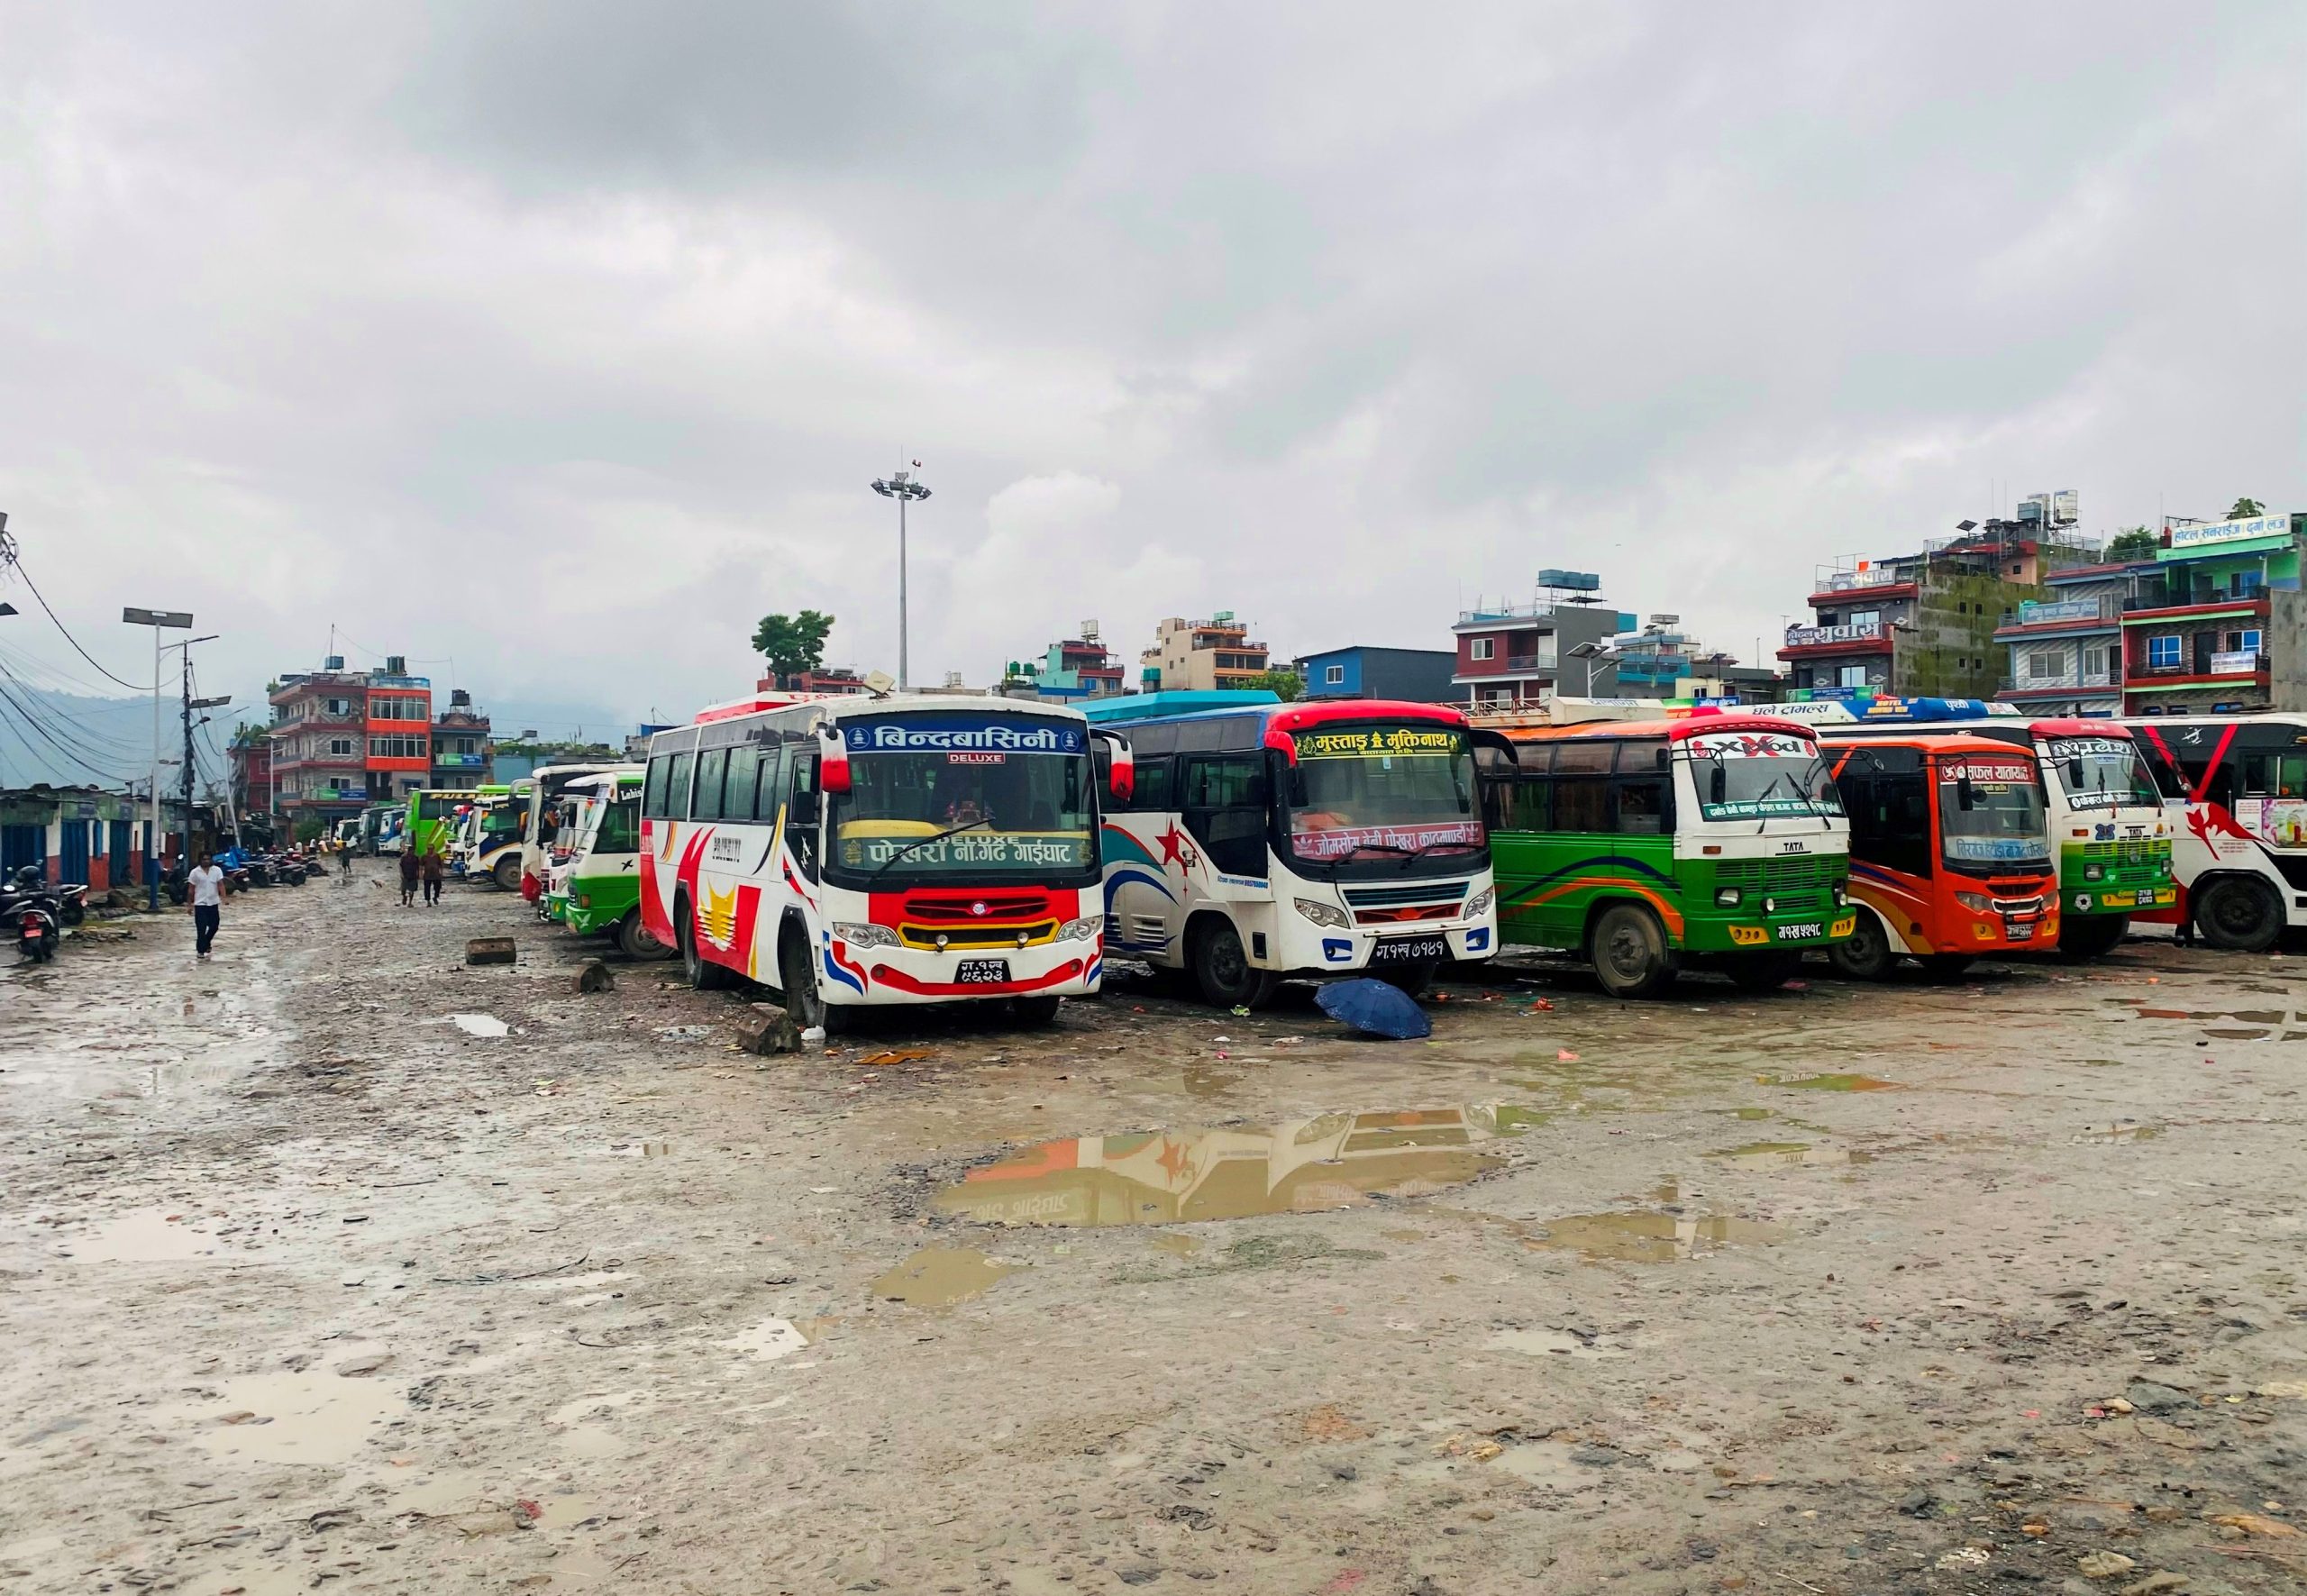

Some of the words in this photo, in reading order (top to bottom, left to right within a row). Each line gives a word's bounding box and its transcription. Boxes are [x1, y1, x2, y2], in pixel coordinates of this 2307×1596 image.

[1813, 624, 1881, 643] सुवास
[1386, 728, 1448, 750] मुक्तिनाथ
[949, 753, 1003, 763] DELUXE
[1994, 766, 2029, 780] यातायात
[2129, 828, 2143, 836] TATA
[1315, 833, 1360, 856] जोमसोम
[1386, 828, 1417, 851] पोखरा
[1783, 841, 1804, 852] TATA
[869, 839, 947, 863] पोखरा
[1015, 839, 1071, 865] गाईघाट
